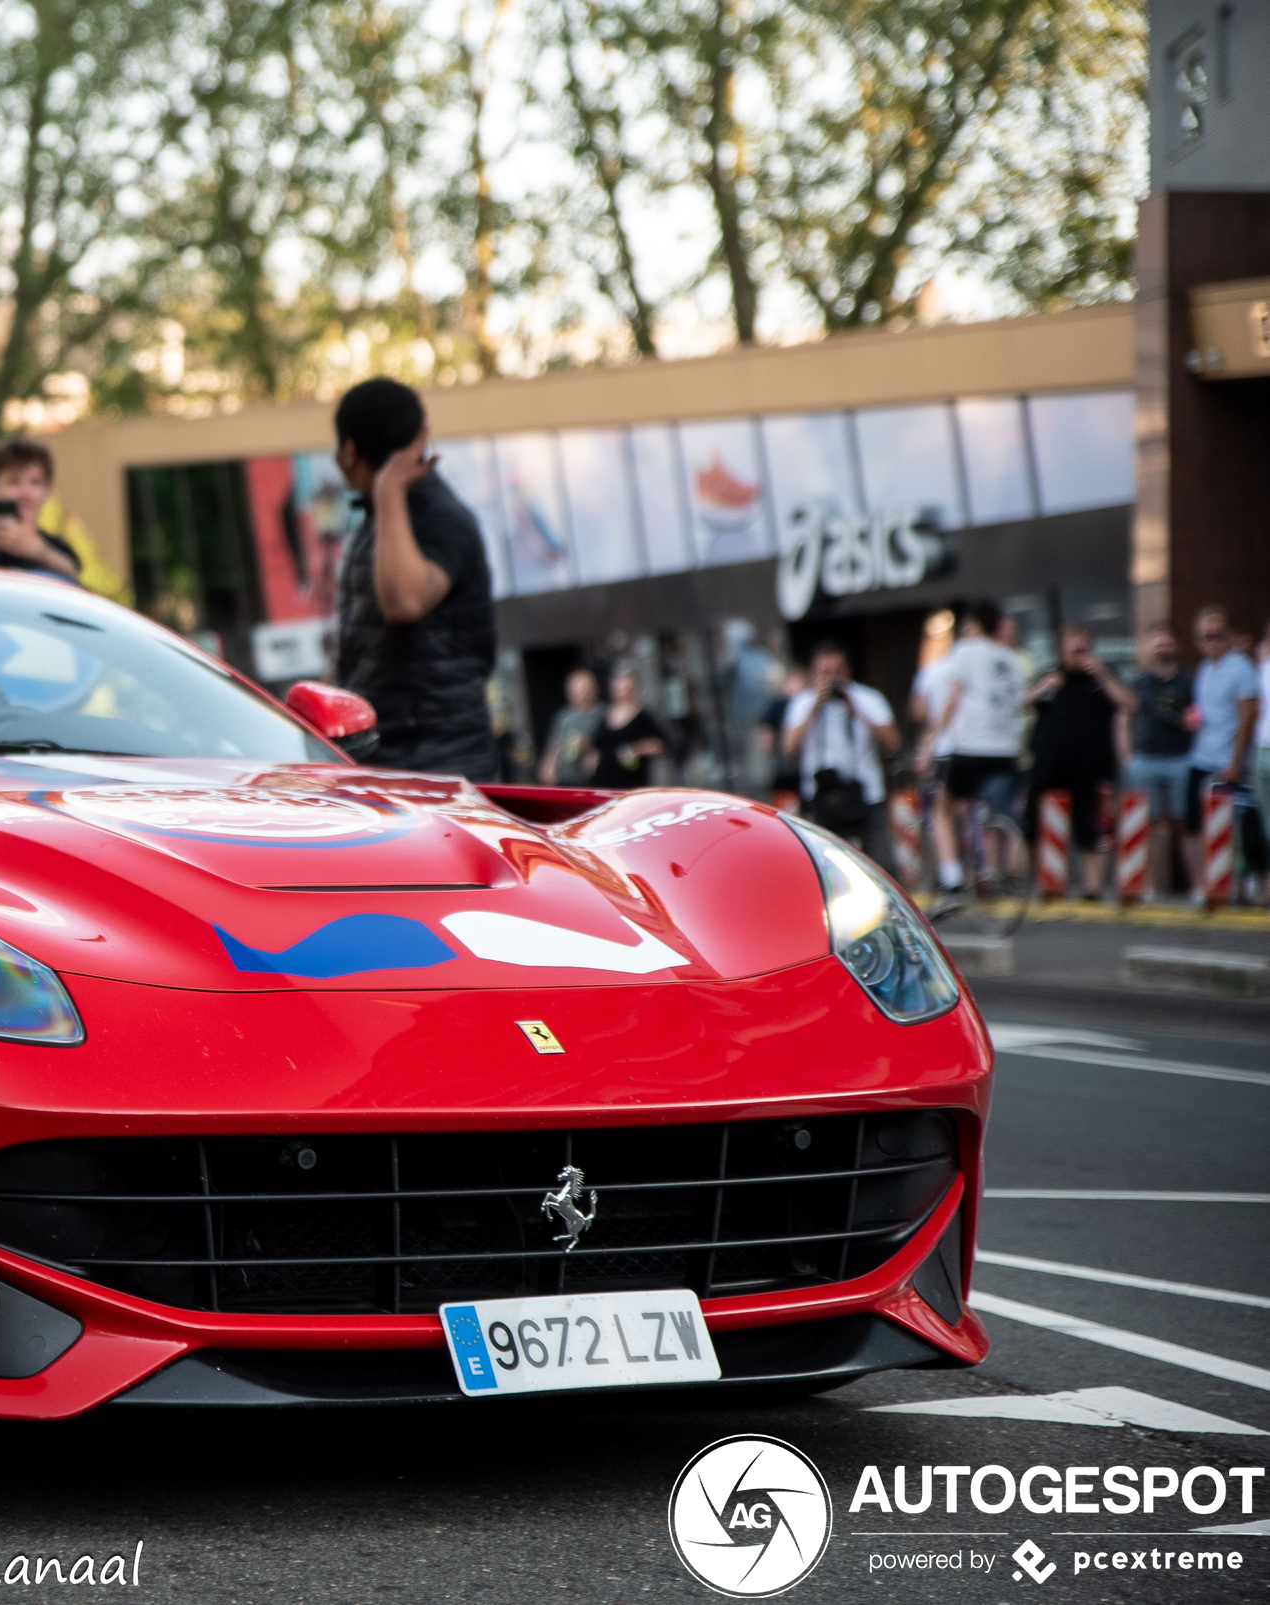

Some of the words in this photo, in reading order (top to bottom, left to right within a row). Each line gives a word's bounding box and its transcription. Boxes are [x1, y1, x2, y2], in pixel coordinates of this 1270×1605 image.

[487, 1315, 610, 1371] 9672
[613, 1311, 702, 1364] LZW
[467, 1356, 485, 1376] E
